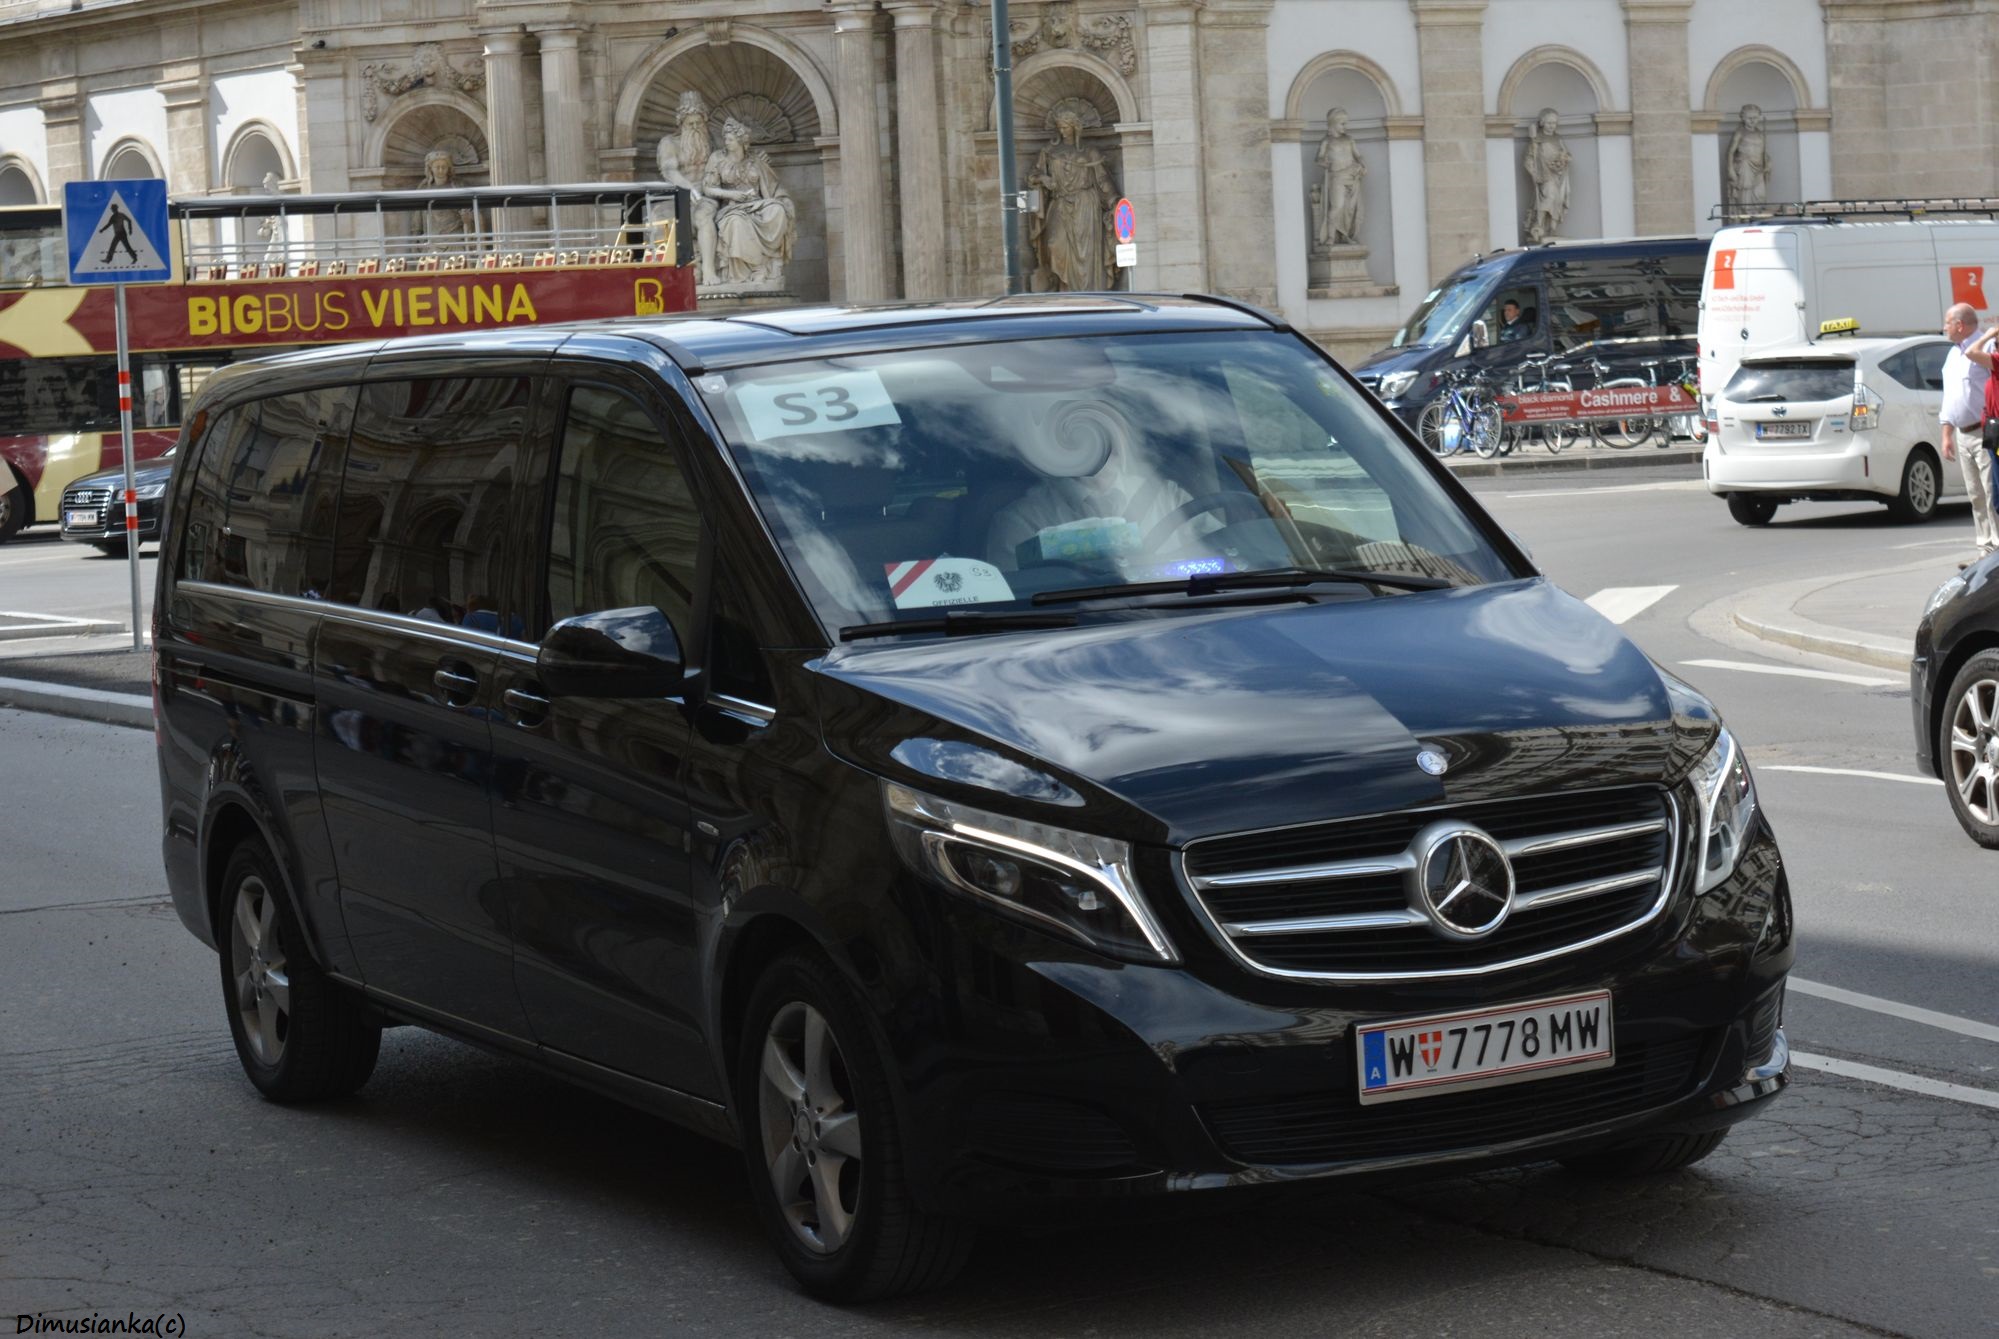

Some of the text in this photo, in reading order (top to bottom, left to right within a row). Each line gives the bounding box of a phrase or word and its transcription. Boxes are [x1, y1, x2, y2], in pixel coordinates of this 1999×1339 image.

[188, 283, 538, 336] BIGBUS VIENNA
[1823, 319, 1850, 332] TAXI
[773, 386, 859, 426] S3
[1540, 391, 1574, 403] diamond
[1580, 389, 1658, 408] Cashmere
[1669, 386, 1682, 402] &
[1389, 1006, 1600, 1078] W 7778 MW
[1370, 1067, 1381, 1080] A
